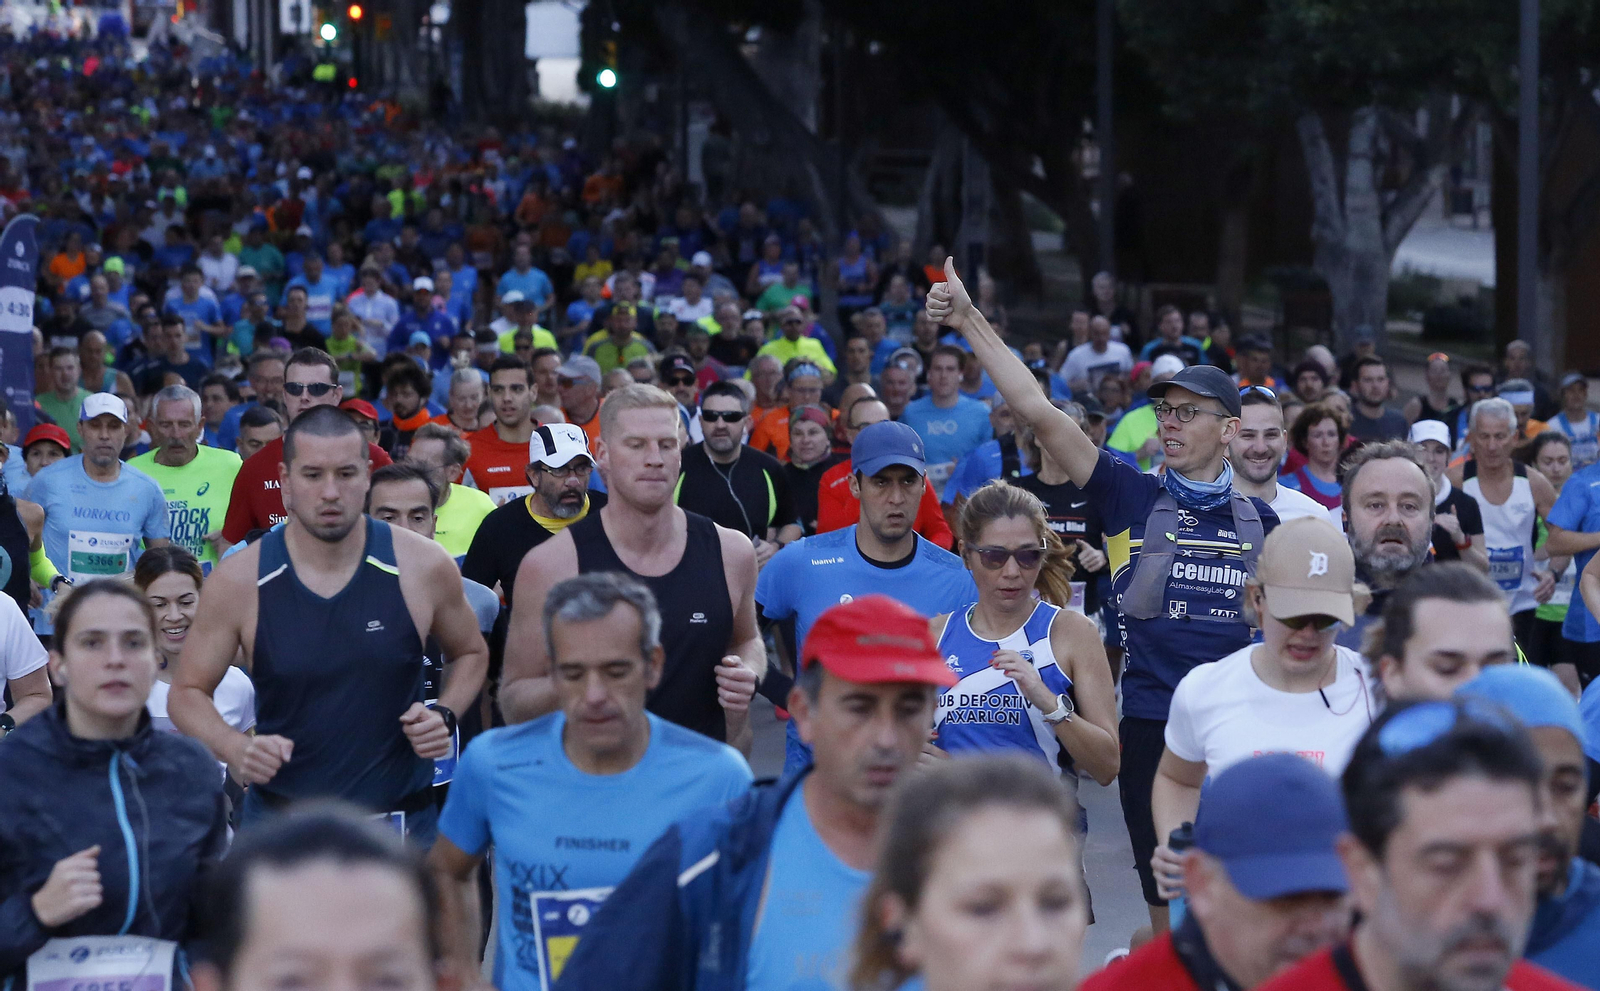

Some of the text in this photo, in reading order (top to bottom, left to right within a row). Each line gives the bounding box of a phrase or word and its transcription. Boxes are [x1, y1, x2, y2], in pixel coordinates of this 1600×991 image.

[264, 480, 282, 490] MA
[73, 506, 132, 522] MOROCCO
[169, 507, 211, 525] TOCK
[88, 555, 114, 567] 5366
[1308, 550, 1329, 578] D
[960, 694, 1033, 710] DEPORTIV
[945, 707, 1020, 725] AXARLÓN
[555, 836, 630, 851] FINISHER
